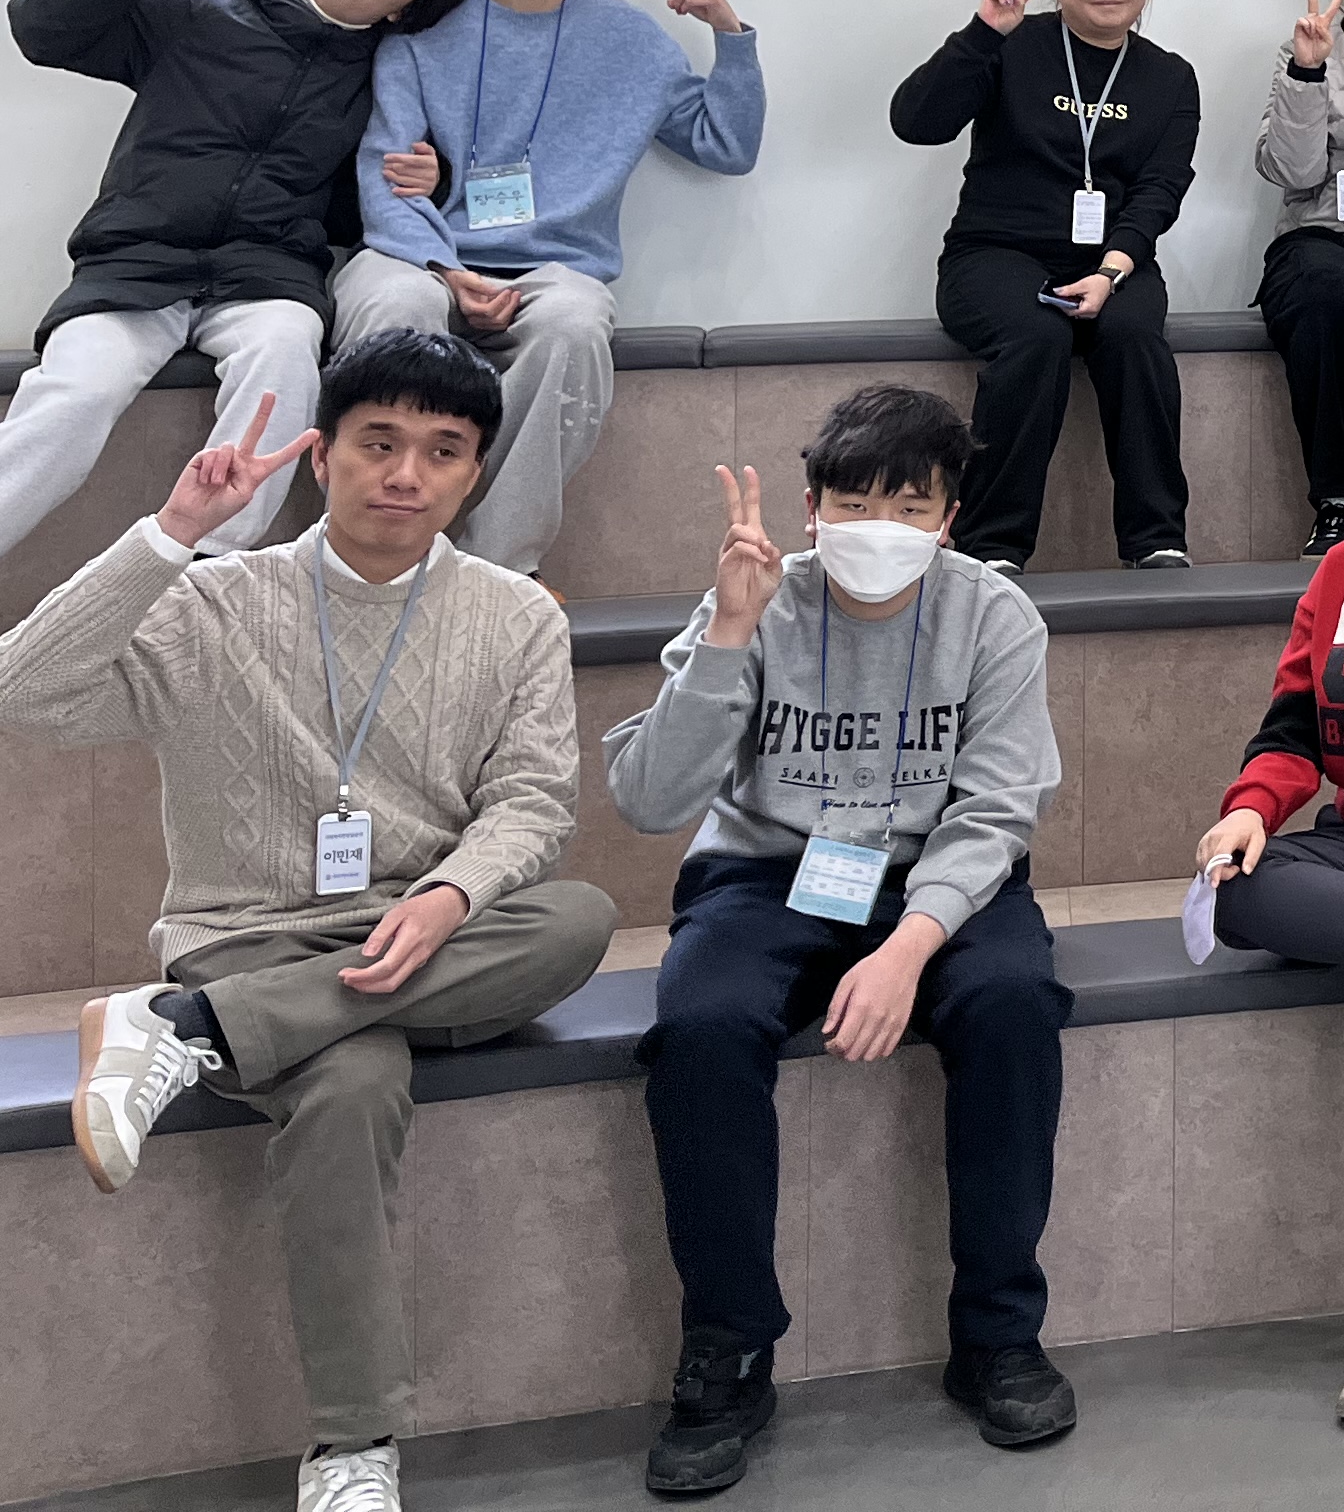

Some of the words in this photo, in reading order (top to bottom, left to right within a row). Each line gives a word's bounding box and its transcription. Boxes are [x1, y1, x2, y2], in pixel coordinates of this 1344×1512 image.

[1053, 95, 1128, 119] GUESS
[758, 700, 881, 755] HYGGE
[781, 767, 838, 785] SAARI
[891, 764, 948, 783] SELKÄ
[324, 848, 363, 864] 이민재
